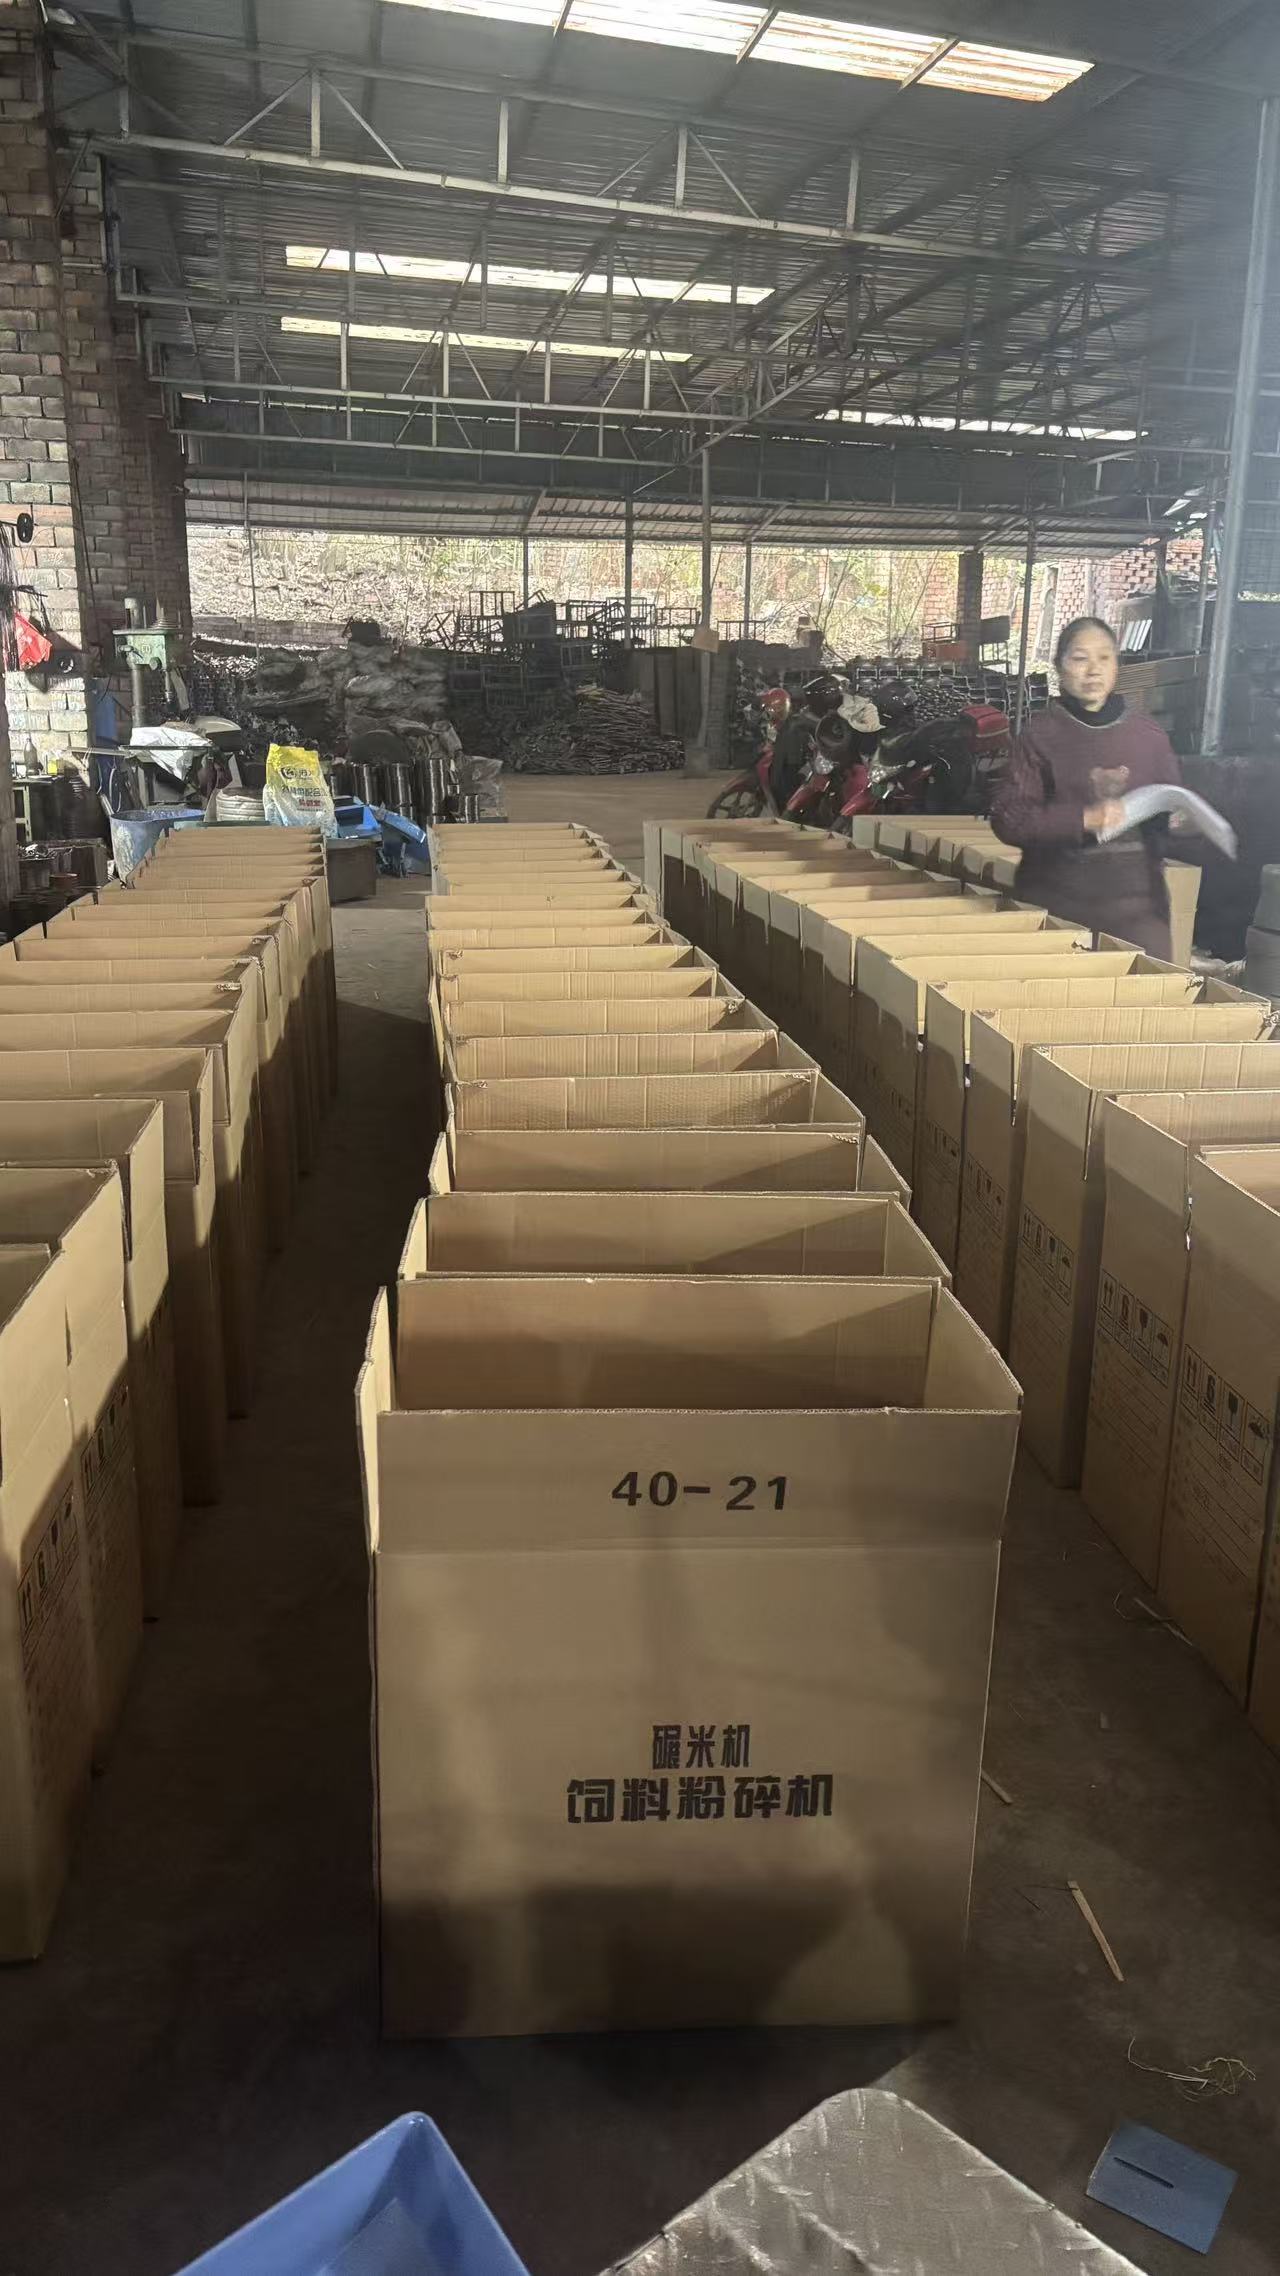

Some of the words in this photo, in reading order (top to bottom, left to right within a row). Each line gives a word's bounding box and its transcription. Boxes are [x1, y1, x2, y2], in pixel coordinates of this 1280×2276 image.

[611, 1470, 787, 1511] 40-21
[651, 1724, 751, 1771] 碾米机
[566, 1774, 834, 1824] 饲料粉碎机
